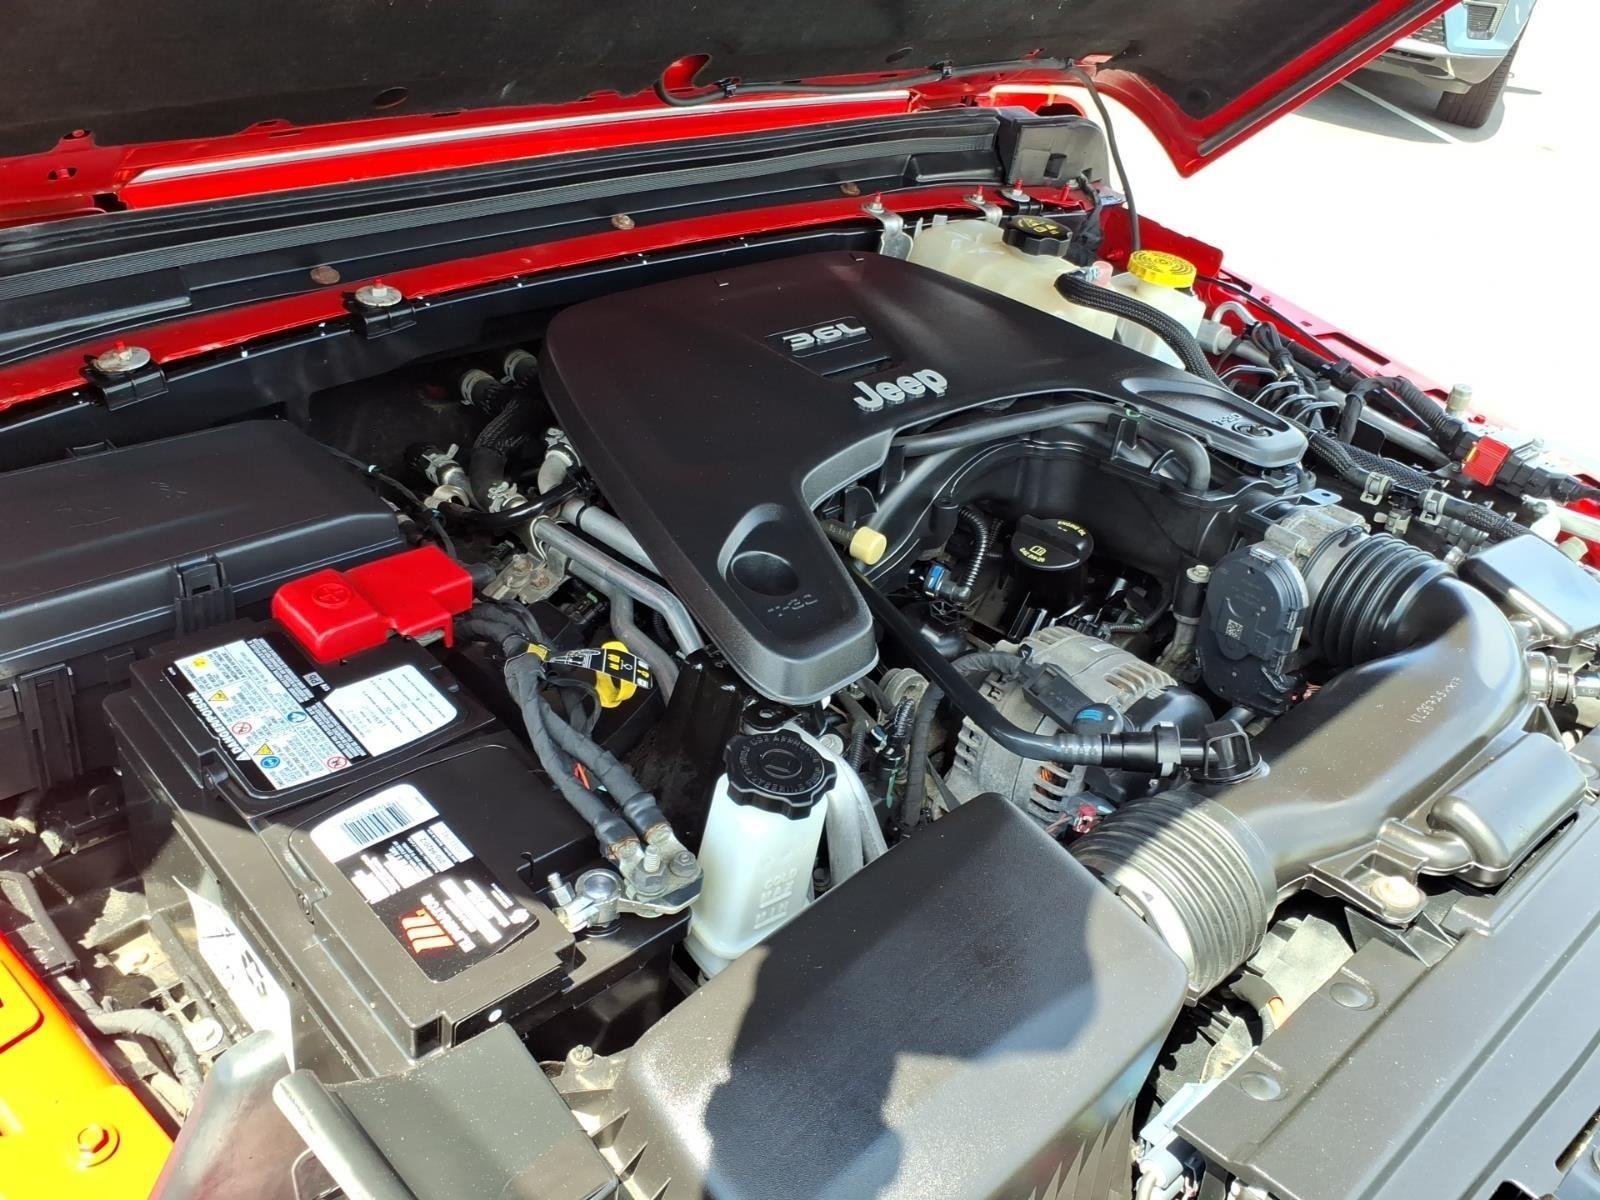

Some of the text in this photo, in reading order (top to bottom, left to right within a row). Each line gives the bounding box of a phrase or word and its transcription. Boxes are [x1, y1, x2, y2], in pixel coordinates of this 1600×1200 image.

[782, 323, 867, 351] 3.6L
[853, 369, 948, 412] Jeep
[186, 692, 244, 755] DANGER/POISON
